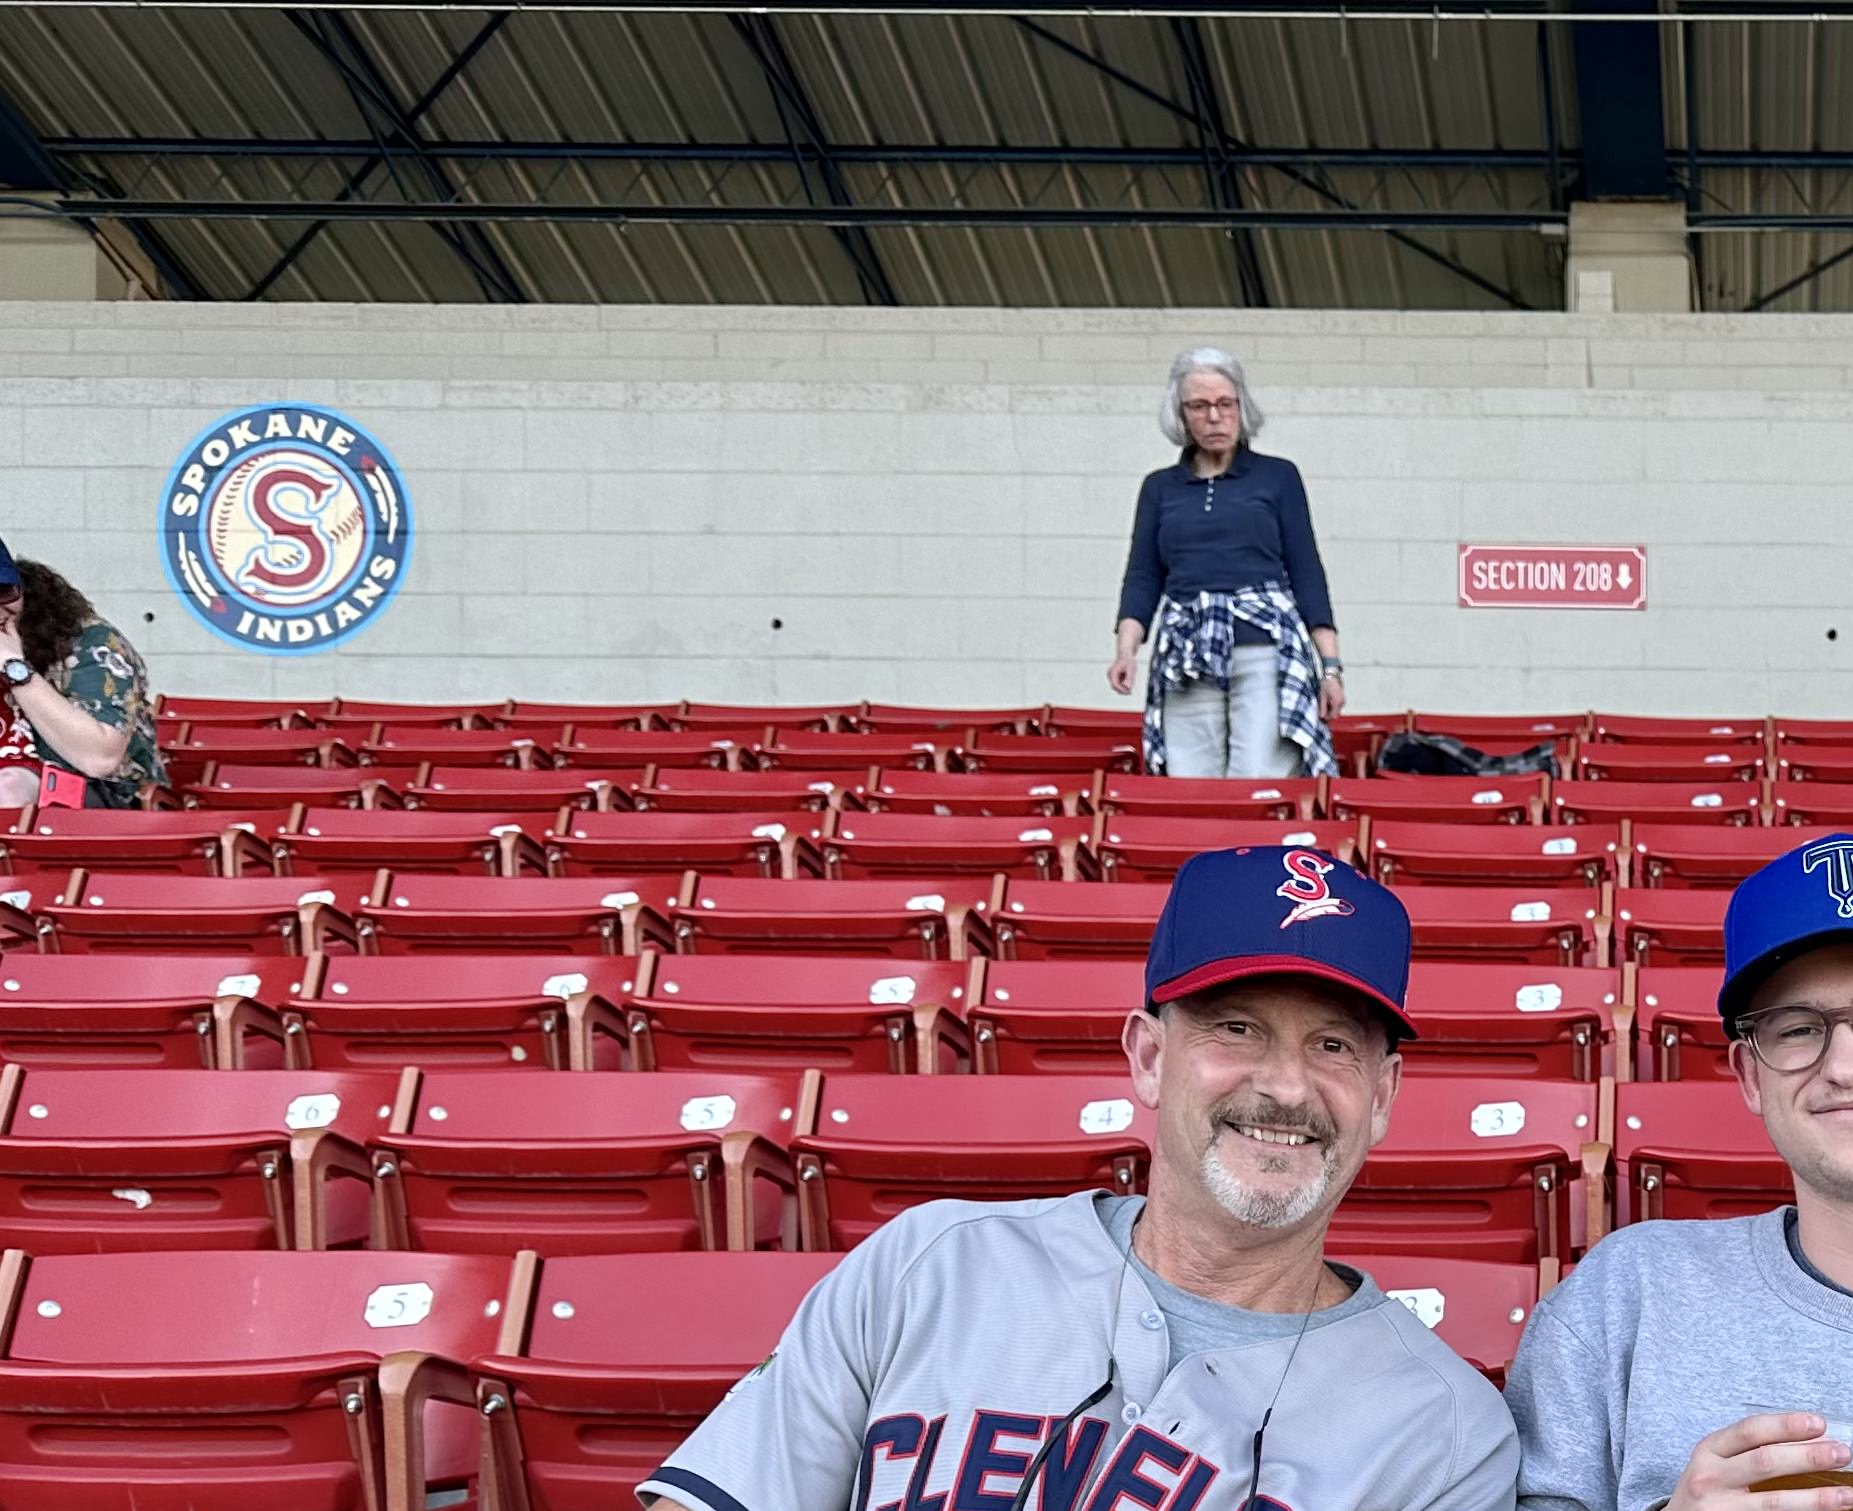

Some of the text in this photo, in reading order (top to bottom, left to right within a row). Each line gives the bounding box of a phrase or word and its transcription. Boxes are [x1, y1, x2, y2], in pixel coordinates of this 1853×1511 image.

[172, 413, 356, 517] SPOKANE
[1472, 560, 1613, 592] SECTION 208
[236, 554, 396, 643] INDIANS
[1276, 849, 1335, 905] S
[304, 1101, 320, 1122] 6
[702, 1102, 715, 1123] 5
[1098, 1106, 1114, 1126] 4
[1490, 1108, 1505, 1131] 3
[392, 1291, 409, 1319] 5
